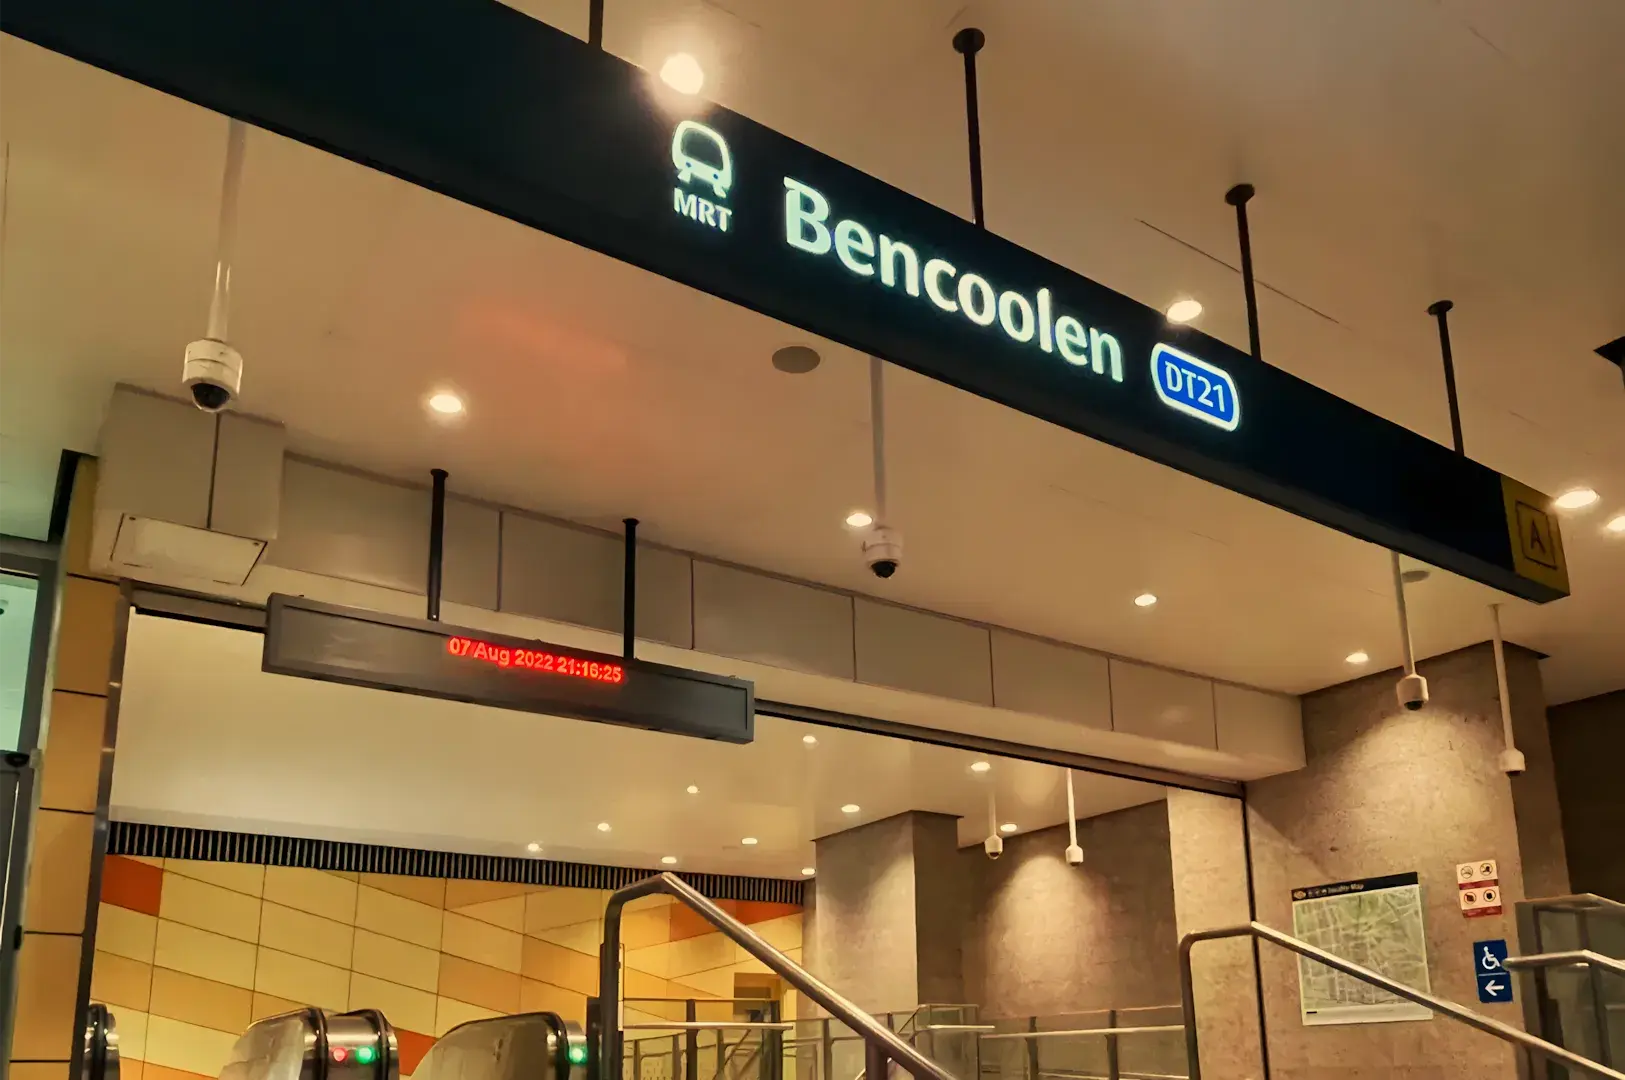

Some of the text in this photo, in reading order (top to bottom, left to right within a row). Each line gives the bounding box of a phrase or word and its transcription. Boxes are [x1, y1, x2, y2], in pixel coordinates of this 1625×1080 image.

[674, 187, 732, 232] MRT
[783, 176, 1124, 383] Bencoolen
[1164, 360, 1225, 413] DT21
[1530, 518, 1546, 555] A
[449, 637, 622, 683] 07 Aug 2022 21:16:25
